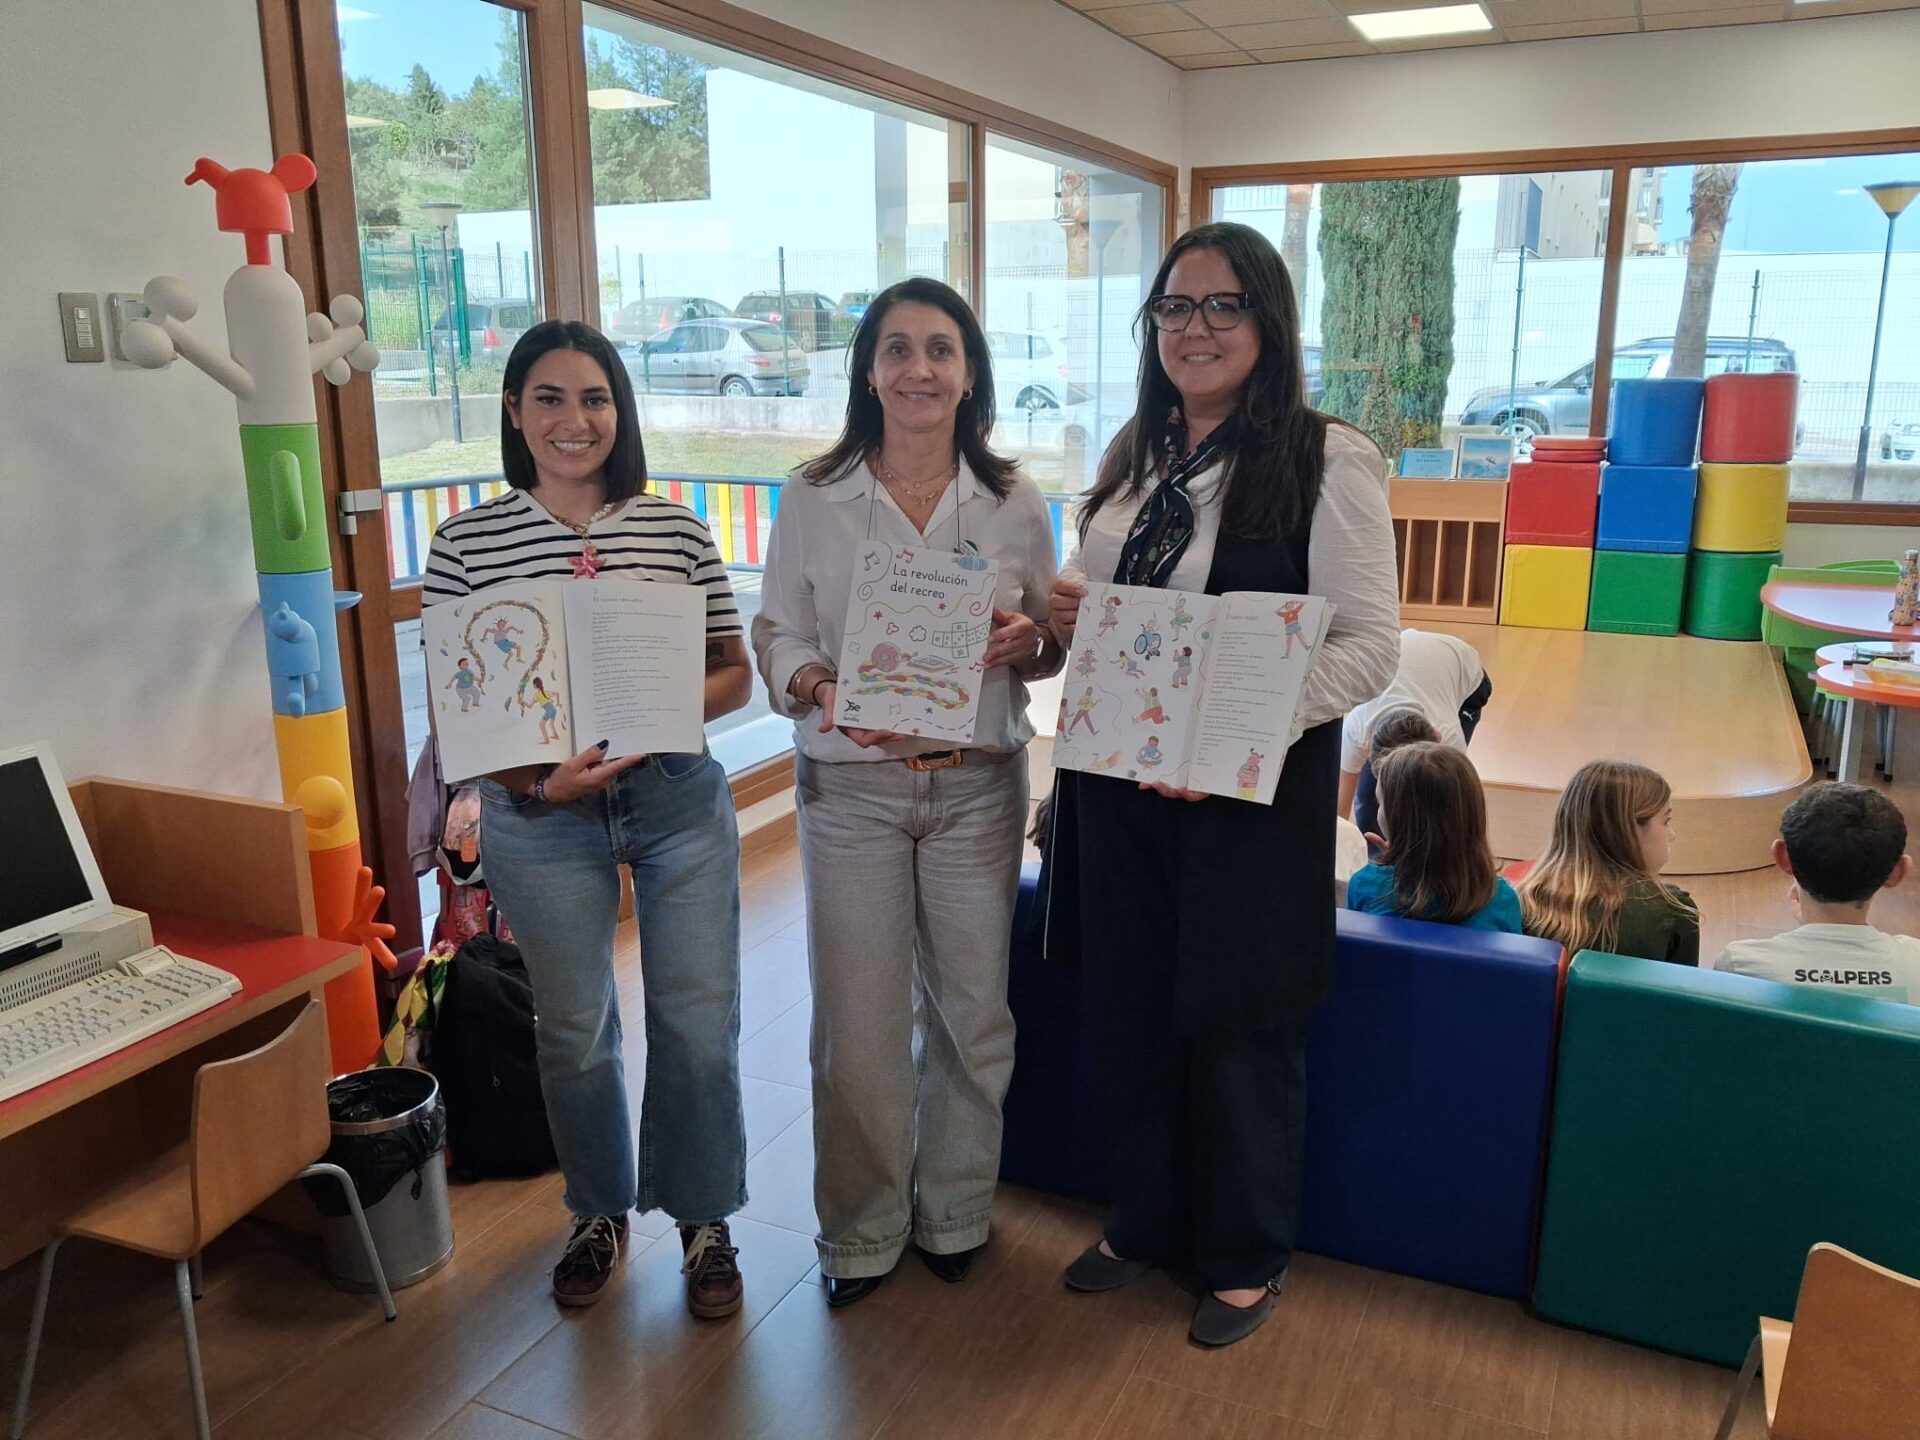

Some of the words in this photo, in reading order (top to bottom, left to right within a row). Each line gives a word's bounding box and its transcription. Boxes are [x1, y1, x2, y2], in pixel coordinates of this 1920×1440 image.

[893, 563, 907, 577] La
[911, 568, 968, 586] revolución
[890, 580, 907, 594] del
[910, 586, 945, 600] recreo
